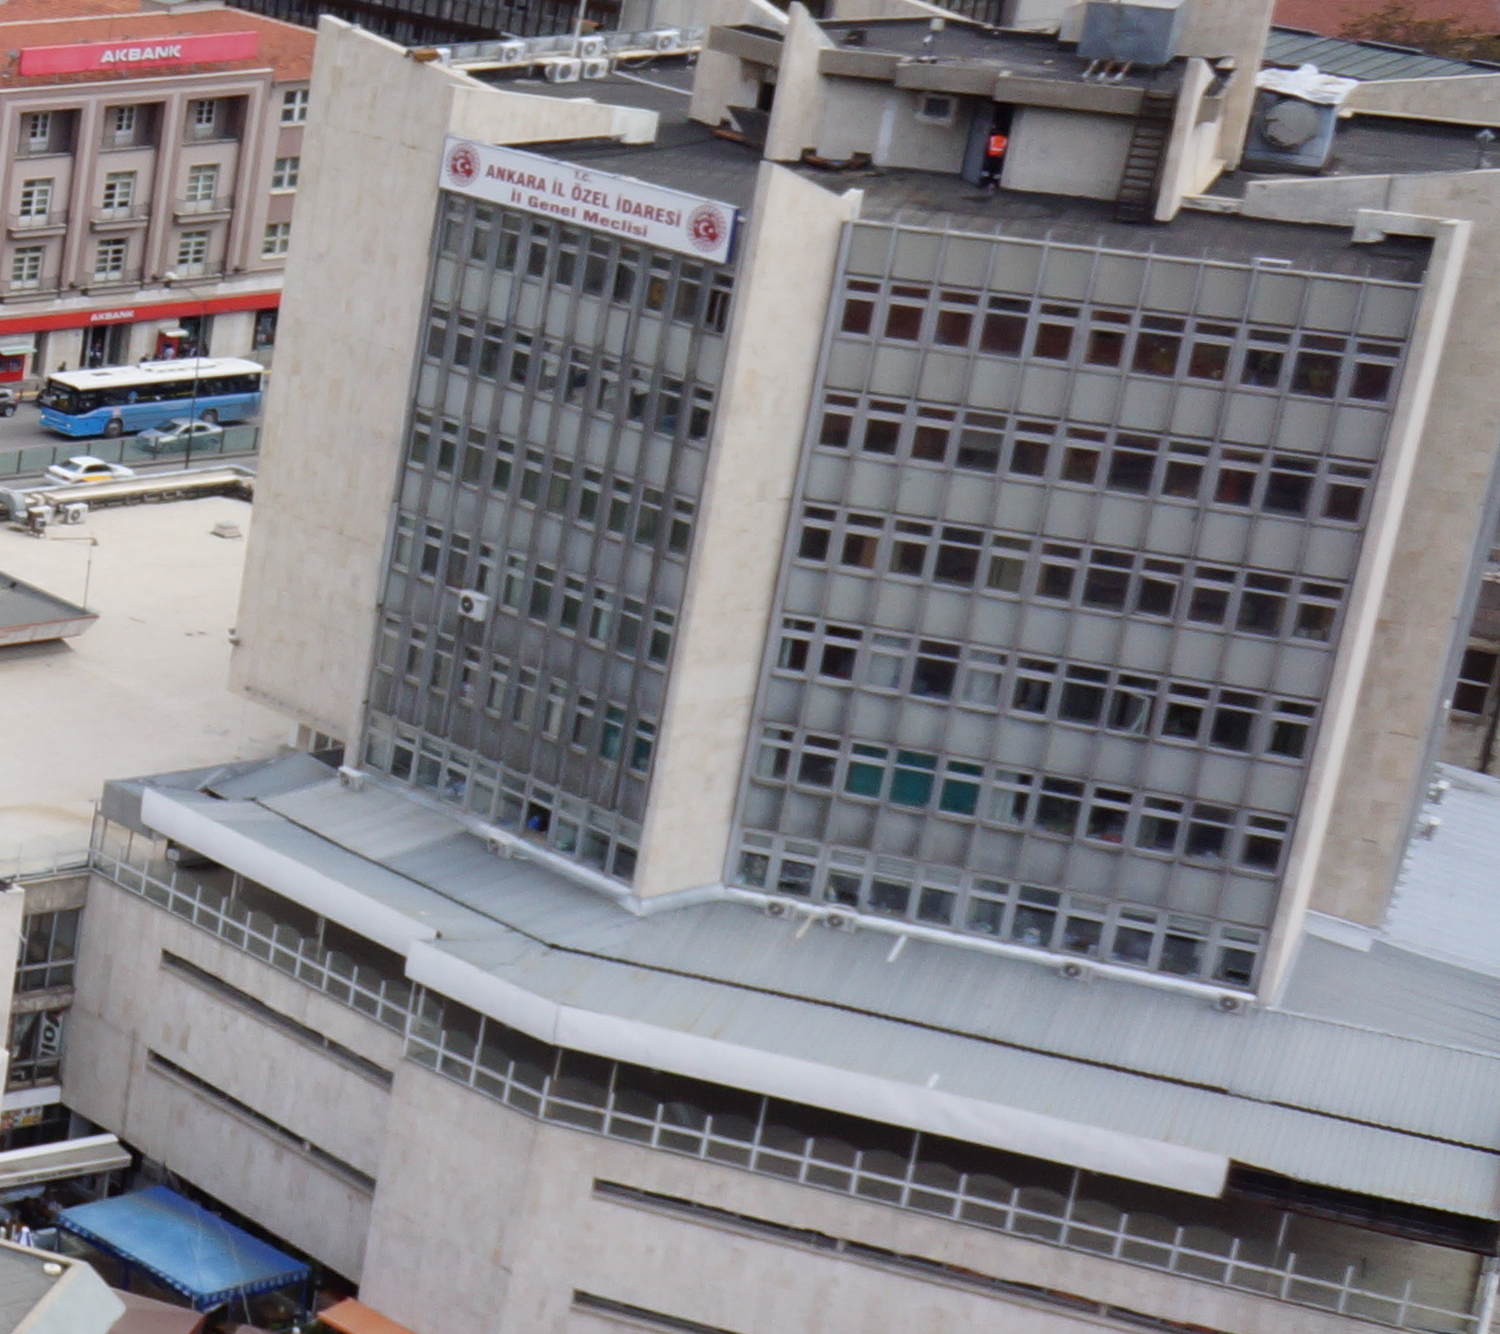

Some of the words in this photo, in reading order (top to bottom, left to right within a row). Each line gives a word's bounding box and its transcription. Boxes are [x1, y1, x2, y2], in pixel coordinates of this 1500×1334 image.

[100, 44, 182, 63] AKBANK
[485, 164, 548, 196] ANKARA
[550, 173, 567, 197] İL
[571, 177, 610, 210] ÖZEL
[615, 190, 682, 229] İDARESİ
[526, 194, 579, 222] Genel
[582, 207, 648, 239] Meclisi
[90, 310, 135, 322] AKBANK
